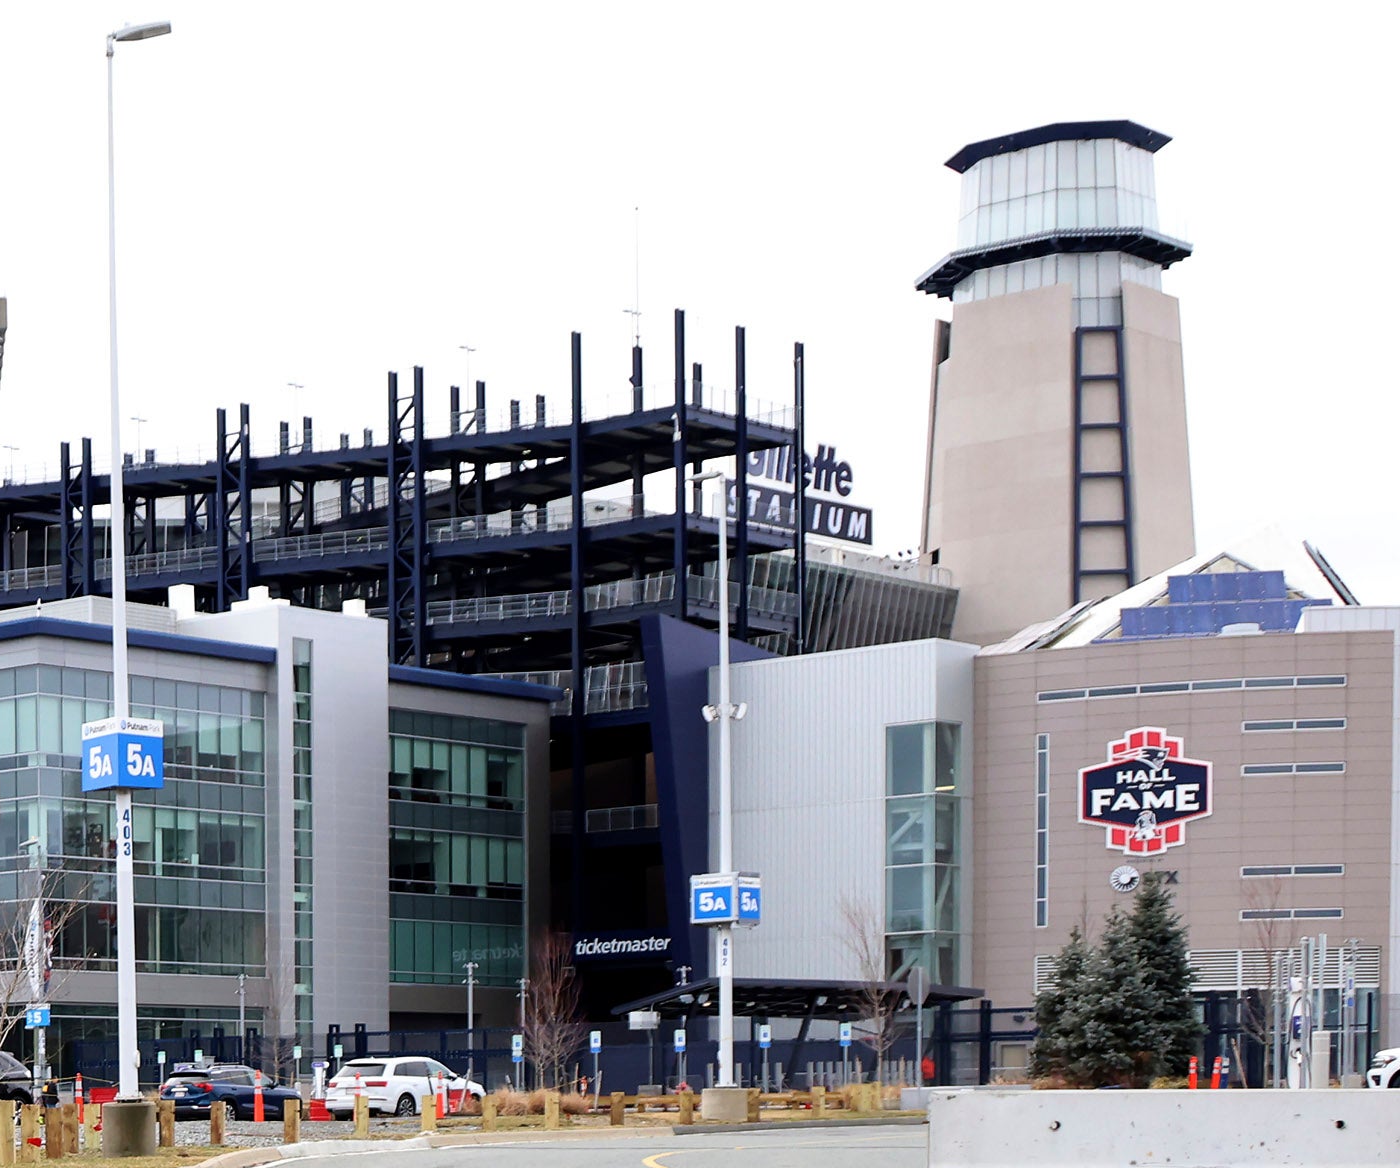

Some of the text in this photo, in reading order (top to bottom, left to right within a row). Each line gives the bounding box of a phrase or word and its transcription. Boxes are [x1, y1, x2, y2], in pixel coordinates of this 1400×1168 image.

[127, 722, 148, 731] Putnam
[89, 745, 113, 779] 5A
[127, 743, 156, 778] 5A
[1116, 768, 1176, 784] HALL
[1091, 783, 1200, 816] FAME
[122, 809, 131, 857] 403
[699, 891, 727, 912] 5A
[741, 891, 760, 913] 5A
[575, 935, 671, 955] ticketmaster
[33, 1011, 42, 1023] 5
